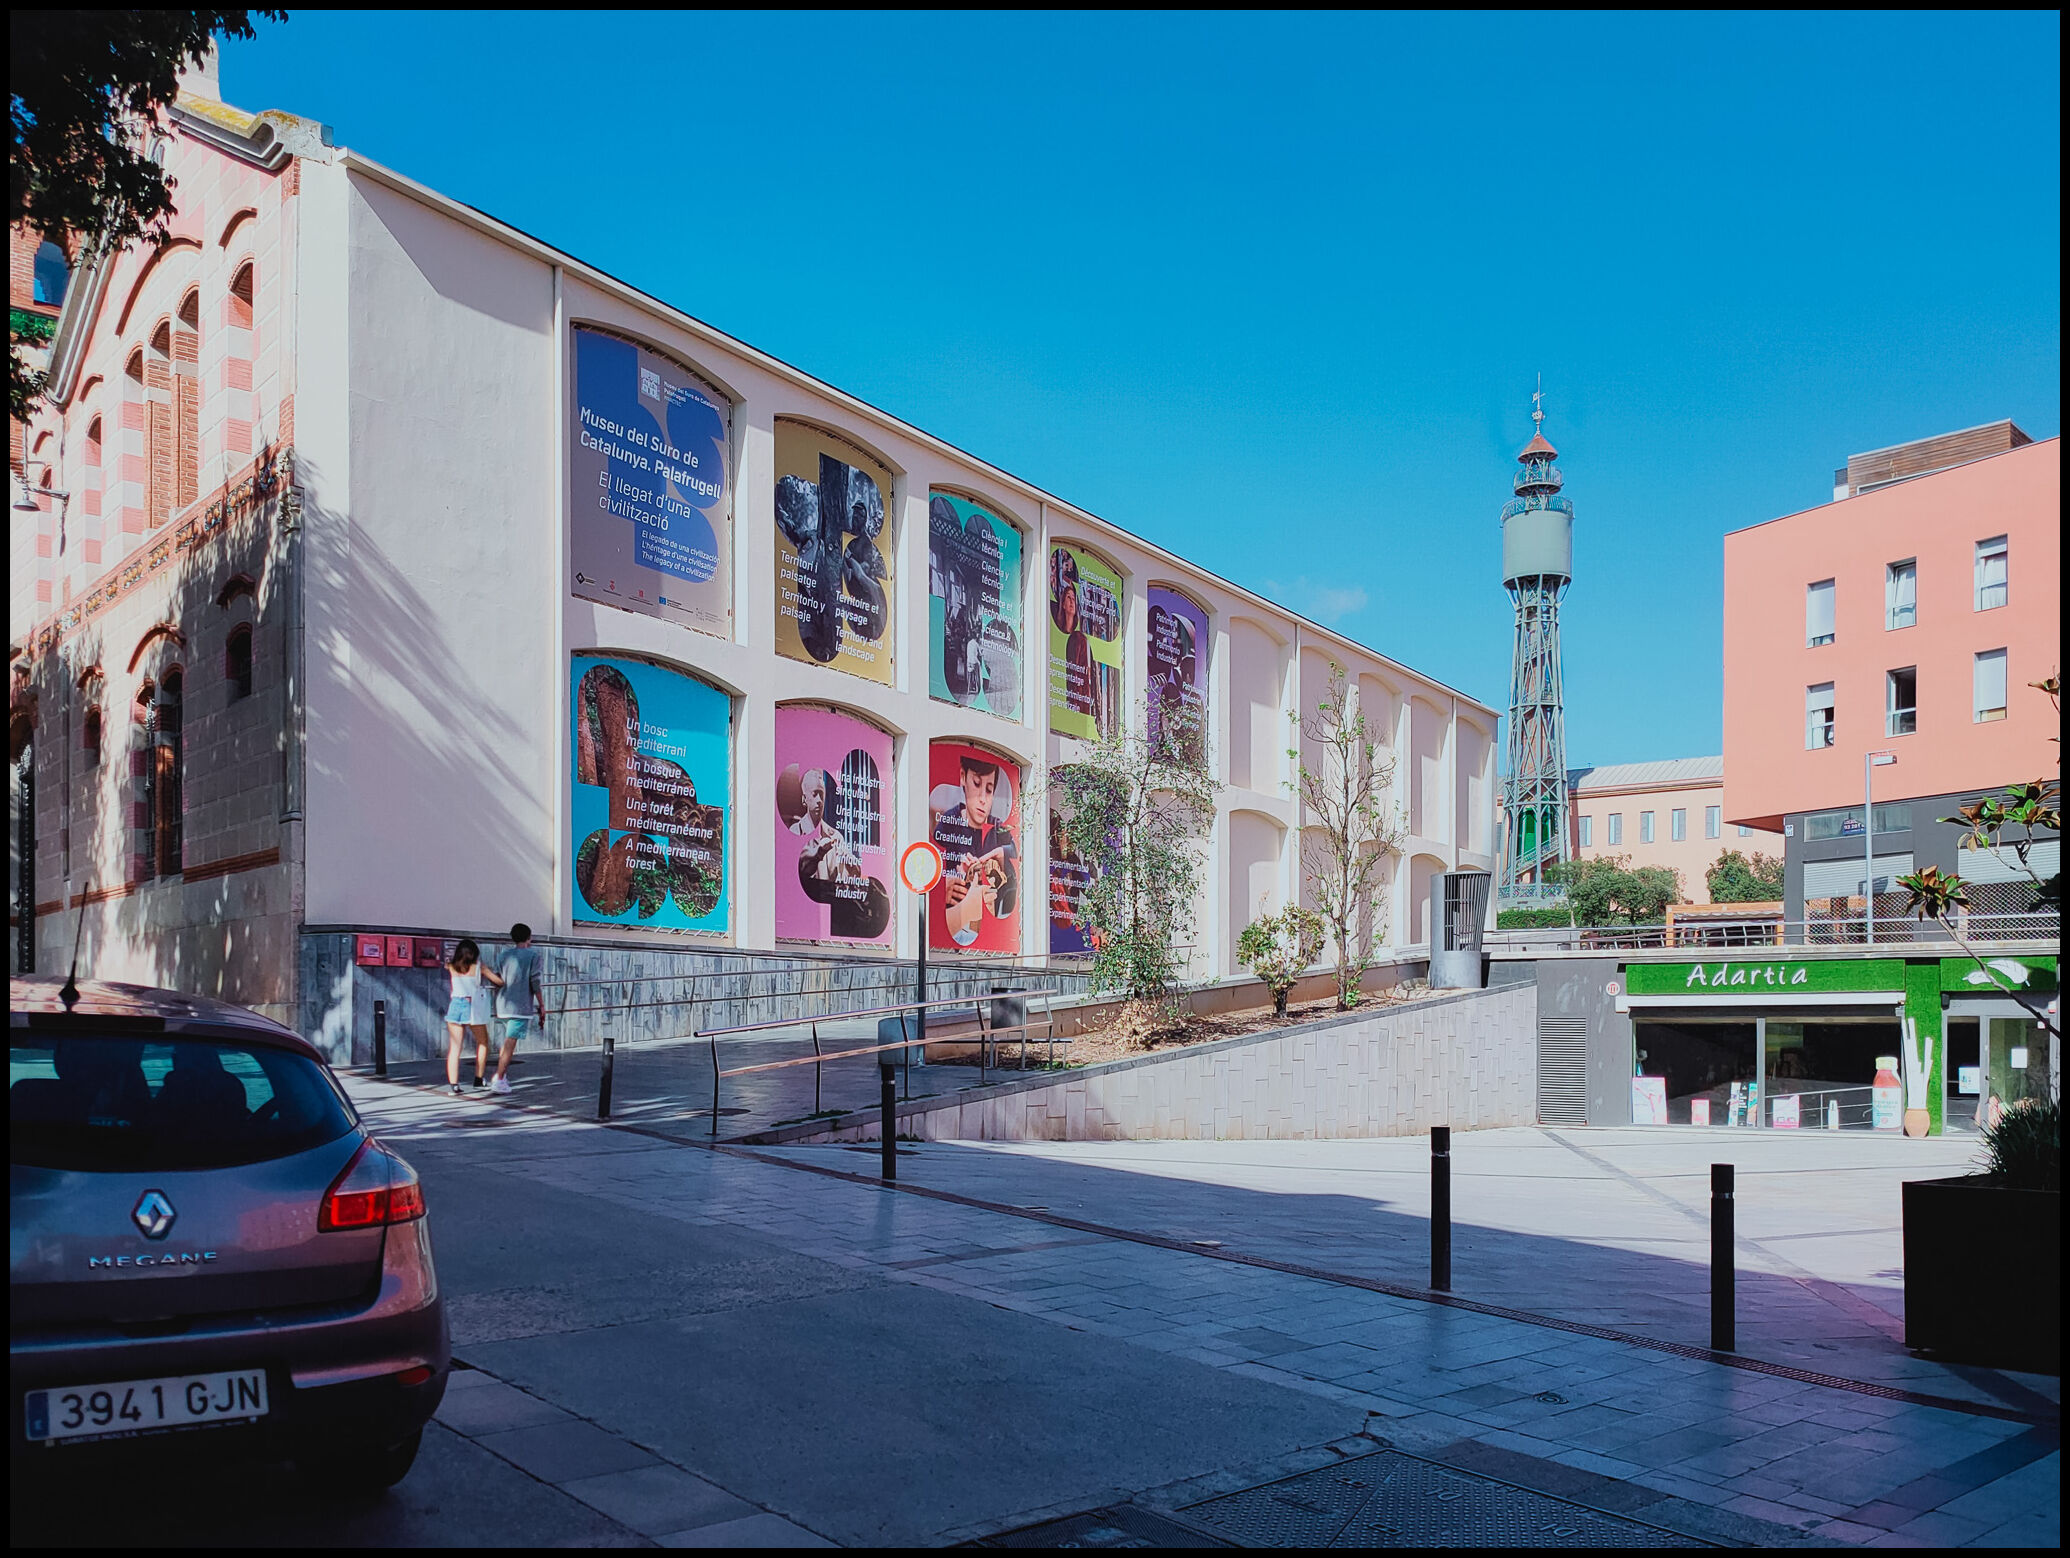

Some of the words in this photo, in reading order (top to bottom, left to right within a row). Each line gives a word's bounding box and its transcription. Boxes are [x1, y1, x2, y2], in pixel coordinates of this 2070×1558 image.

[580, 406, 624, 438] Museu
[627, 427, 648, 448] del
[650, 436, 680, 461] Suro
[683, 451, 699, 468] de
[580, 430, 651, 472] Catalunya.
[654, 459, 721, 499] Palafrugell
[599, 471, 612, 490] El
[615, 477, 653, 505] llegat
[655, 494, 691, 519] d'una
[599, 495, 669, 531] civilització
[642, 530, 648, 539] El
[649, 532, 669, 546] legado
[670, 539, 678, 549] de
[679, 544, 690, 553] una
[690, 547, 720, 564] civilización
[981, 529, 1004, 547] Ciència
[981, 542, 1004, 560] tècnica
[642, 550, 654, 561] The
[654, 554, 674, 569] legacy
[674, 563, 680, 571] of
[686, 566, 715, 582] civilization
[672, 551, 688, 562] d'une
[688, 557, 718, 573] civilisation
[780, 550, 814, 572] Territori
[814, 562, 818, 574] i
[981, 560, 1004, 578] Ciencia
[1005, 572, 1010, 581] y
[780, 568, 817, 588] paisatge
[981, 574, 1004, 591] técnica
[780, 586, 819, 610] Territorio
[820, 603, 826, 614] y
[836, 590, 870, 612] Territoire
[870, 604, 880, 614] et
[981, 592, 1006, 609] Science
[1006, 603, 1013, 612] et
[780, 604, 811, 622] paisaje
[834, 607, 868, 626] paysage
[836, 626, 868, 646] Territory
[868, 638, 884, 650] and
[1006, 632, 1011, 641] &
[836, 640, 875, 662] landscape
[1156, 640, 1181, 656] Patrimonio
[626, 717, 640, 732] Un
[644, 721, 668, 738] bosc
[626, 736, 687, 758] mediterrani
[626, 756, 640, 770] Un
[644, 760, 682, 780] bosque
[626, 776, 696, 798] mediterráneo
[836, 770, 851, 783] Una
[852, 772, 886, 790] indústria
[836, 785, 868, 800] singular
[626, 796, 647, 812] Une
[650, 800, 674, 816] forêt
[836, 804, 851, 817] Una
[852, 807, 886, 822] industria
[626, 816, 713, 840] méditerranéenne
[836, 819, 868, 833] singular
[935, 812, 968, 828] Creativitat
[836, 838, 852, 852] Une
[852, 840, 886, 856] industrie
[935, 830, 972, 846] Creatividad
[626, 838, 634, 850] A
[636, 840, 710, 861] mediterranean
[836, 853, 863, 866] unique
[626, 856, 656, 871] forest
[836, 872, 842, 884] A
[843, 874, 870, 887] unique
[836, 886, 868, 902] industry
[1686, 963, 1808, 988] Adartia
[88, 1251, 217, 1269] MEGANE
[60, 1385, 165, 1429] 3941
[186, 1376, 260, 1416] GJN
